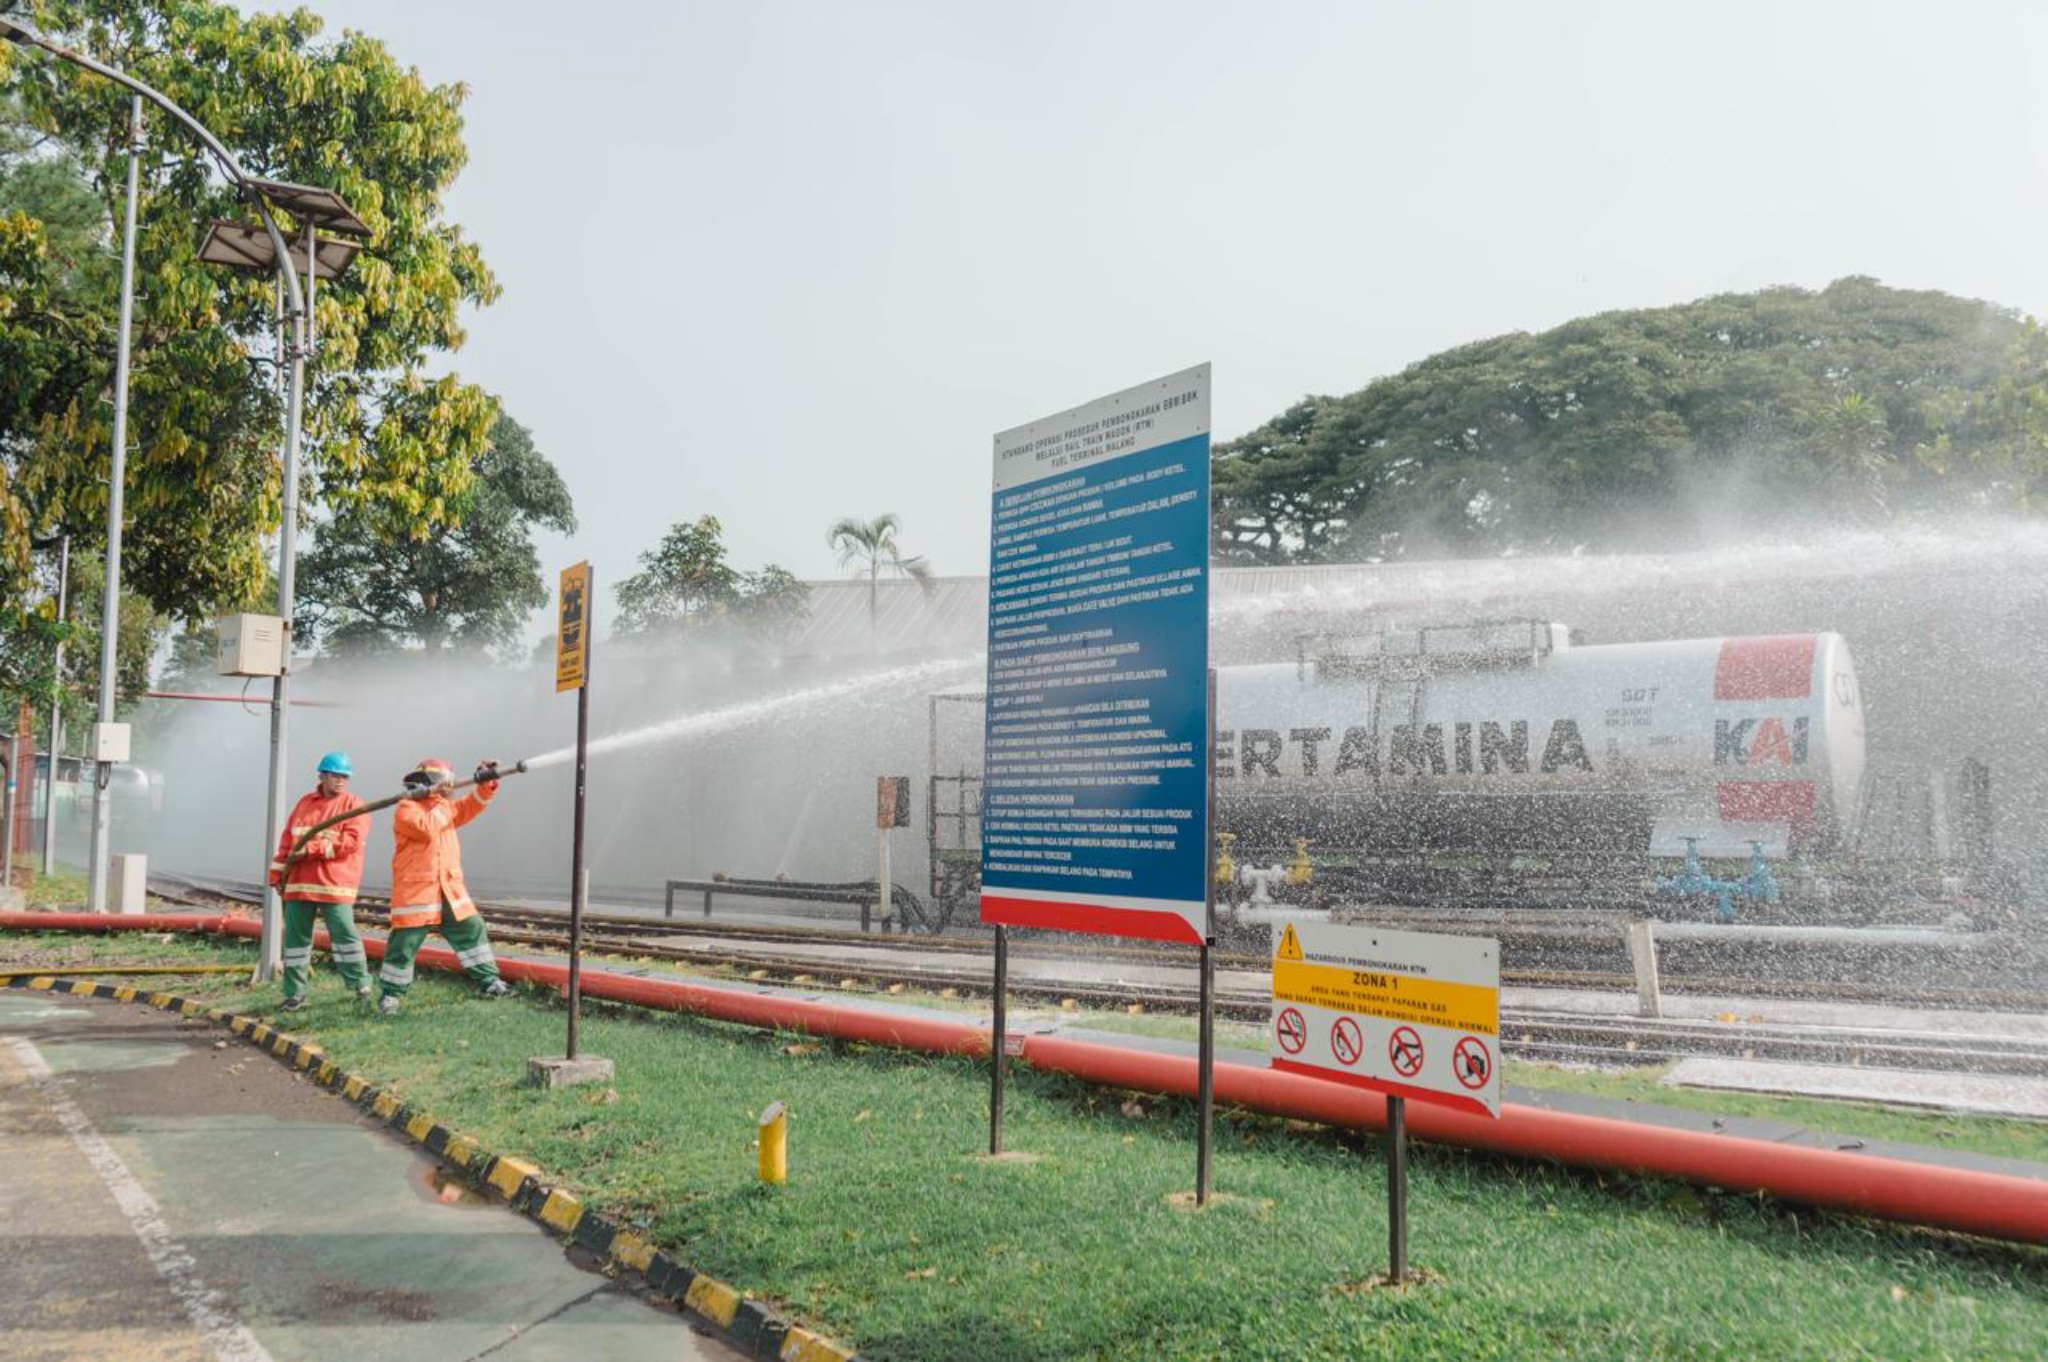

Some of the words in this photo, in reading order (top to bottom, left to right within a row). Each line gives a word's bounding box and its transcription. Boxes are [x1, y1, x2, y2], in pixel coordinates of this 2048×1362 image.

[1102, 402, 1160, 429] PEMBONGKARAN
[1070, 446, 1103, 463] TERMINAL
[1106, 436, 1135, 452] MALANG
[1083, 433, 1102, 447] TRAIN
[1215, 719, 1595, 778] ERTAMINA
[1714, 716, 1810, 767] KAI
[1348, 956, 1408, 972] PEMBONGKARAN
[1353, 972, 1387, 989] ZONA
[1392, 977, 1398, 990] 1
[1420, 1015, 1456, 1028] OPERASI
[1458, 1021, 1495, 1036] NORMAL
